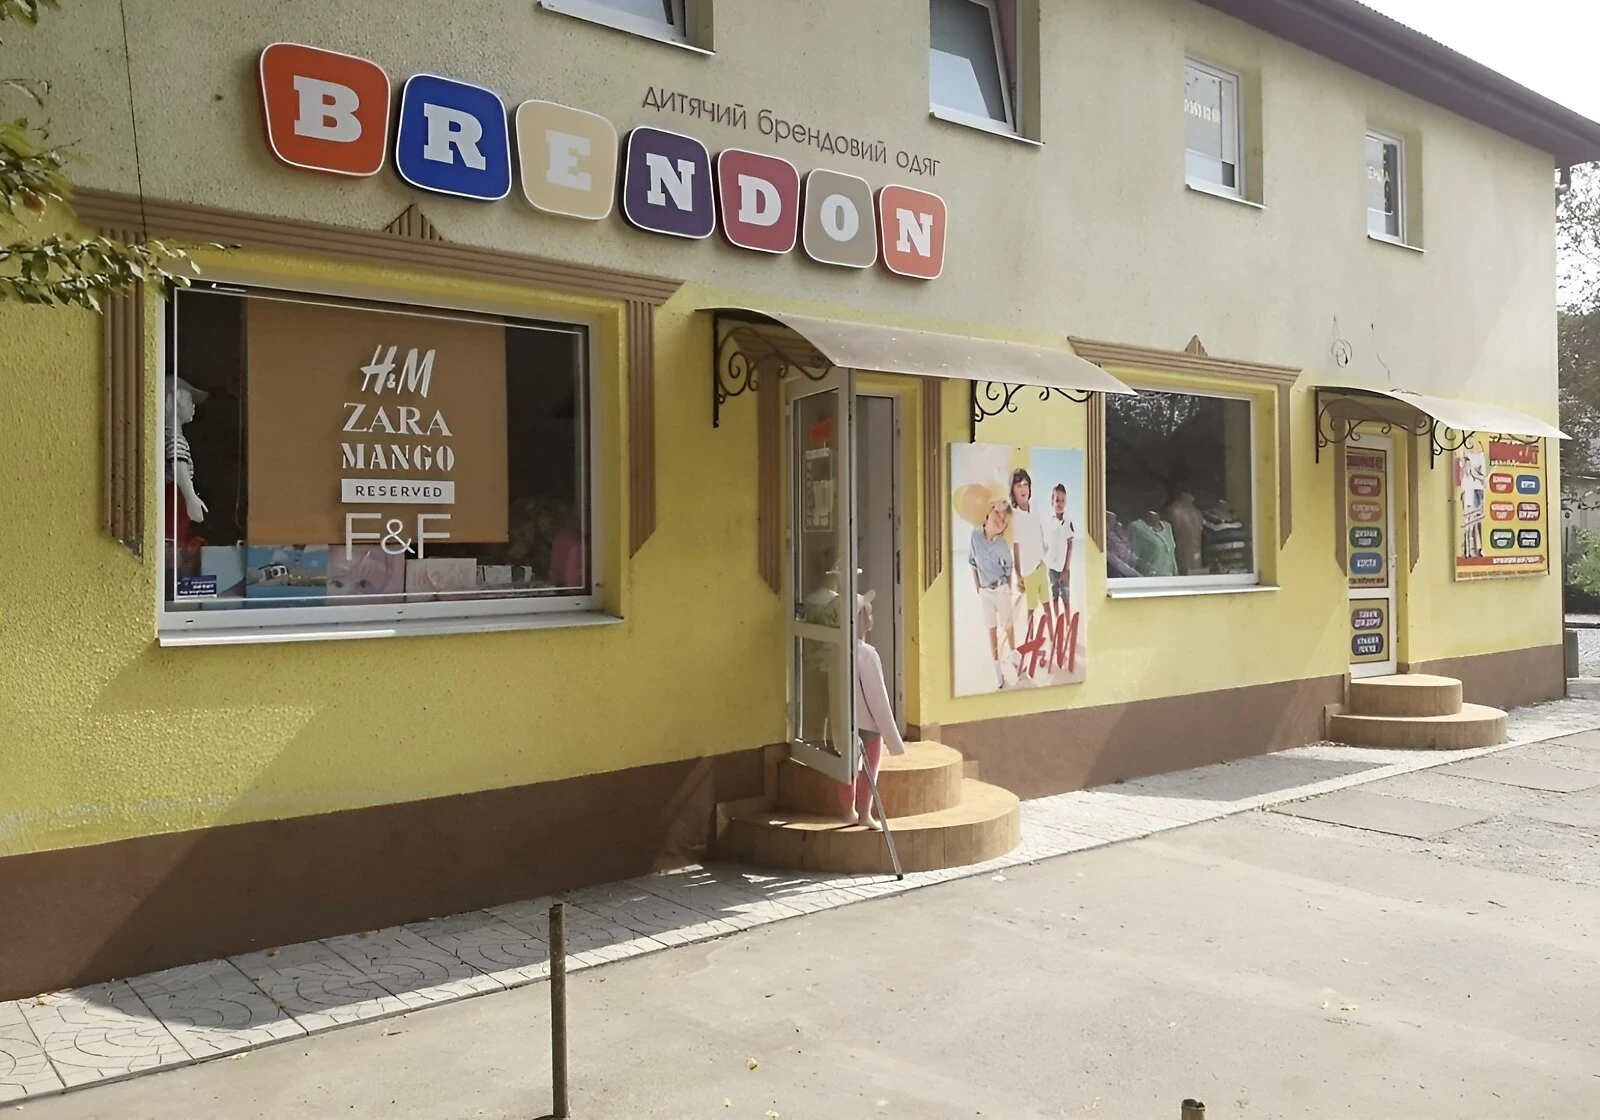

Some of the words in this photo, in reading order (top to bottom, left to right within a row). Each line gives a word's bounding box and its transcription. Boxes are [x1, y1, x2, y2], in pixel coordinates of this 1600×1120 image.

[293, 74, 933, 258] BRENDON
[757, 109, 887, 164] брендовий
[896, 150, 941, 177] одяг
[360, 344, 436, 399] H&M
[342, 402, 452, 437] ZARA
[341, 443, 455, 471] MANGO
[355, 485, 442, 498] RESERVED
[345, 513, 451, 561] F&F
[1016, 612, 1080, 679] H&M
